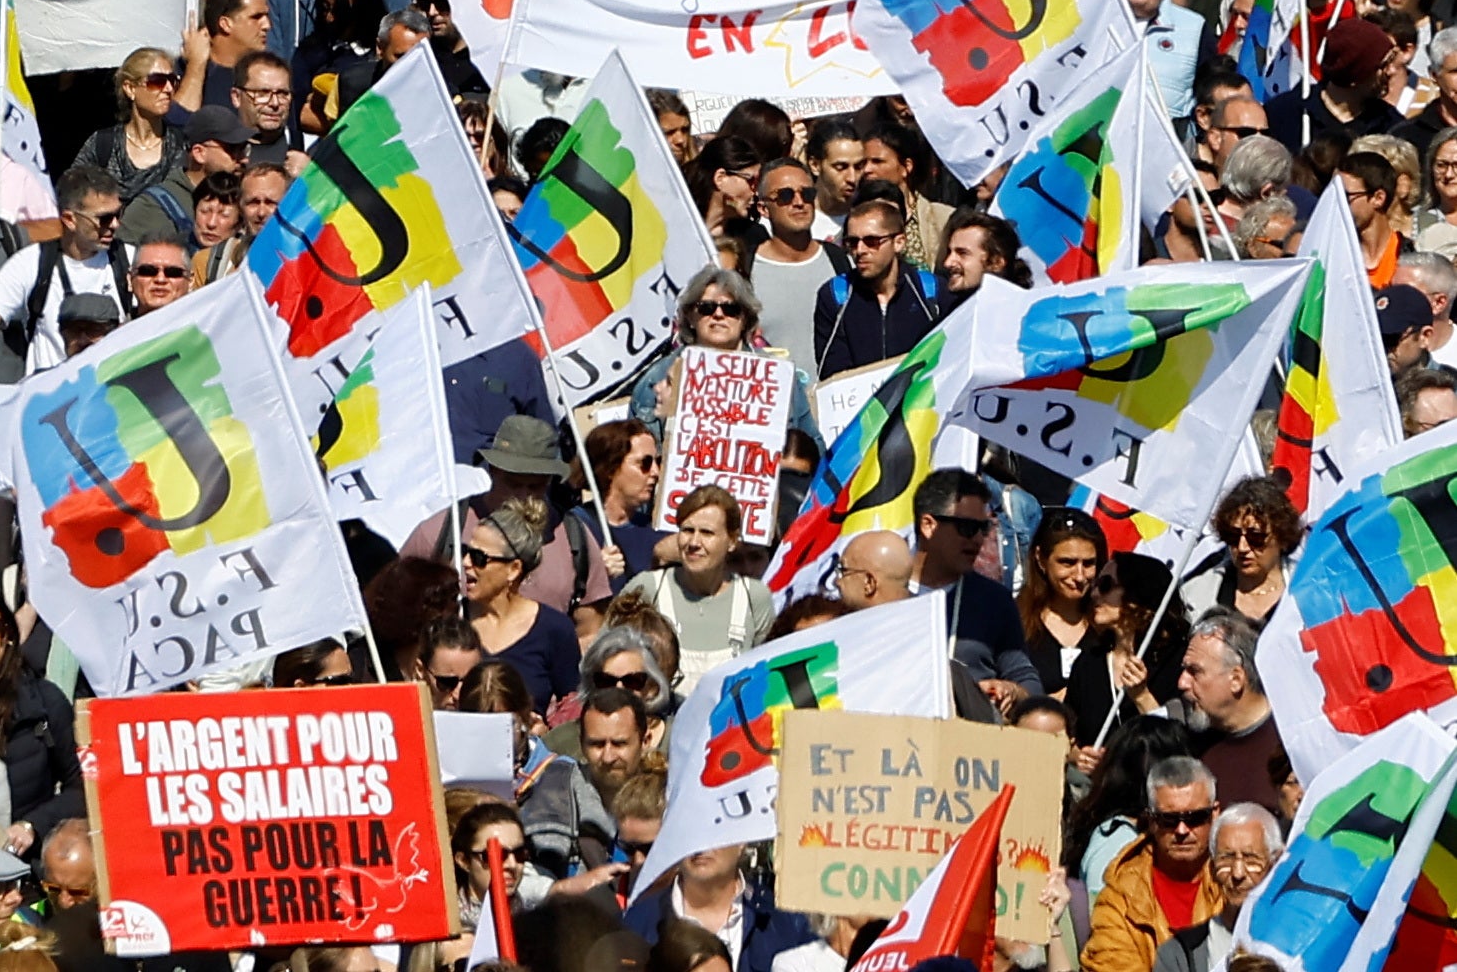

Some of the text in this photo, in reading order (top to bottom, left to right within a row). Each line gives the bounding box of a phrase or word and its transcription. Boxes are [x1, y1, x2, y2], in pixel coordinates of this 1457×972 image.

[686, 9, 765, 60] EN
[682, 369, 780, 407] AVENTURE
[685, 349, 779, 384] LA SEULE
[680, 413, 733, 438] C'EST
[681, 392, 774, 427] POSSIBLE
[676, 431, 783, 478] L'ABOLITION
[674, 467, 771, 498] DE CETTE
[118, 710, 399, 776] L'ARGENT POUR
[809, 737, 1000, 793] ET LÀ ON
[146, 764, 394, 827] LES SALAIRES
[811, 785, 892, 814] N'EST
[913, 785, 976, 825] PAS
[161, 818, 395, 877] PAS POUR LA
[823, 816, 1019, 869] LÉGITIM?
[202, 877, 348, 930] GUERRE
